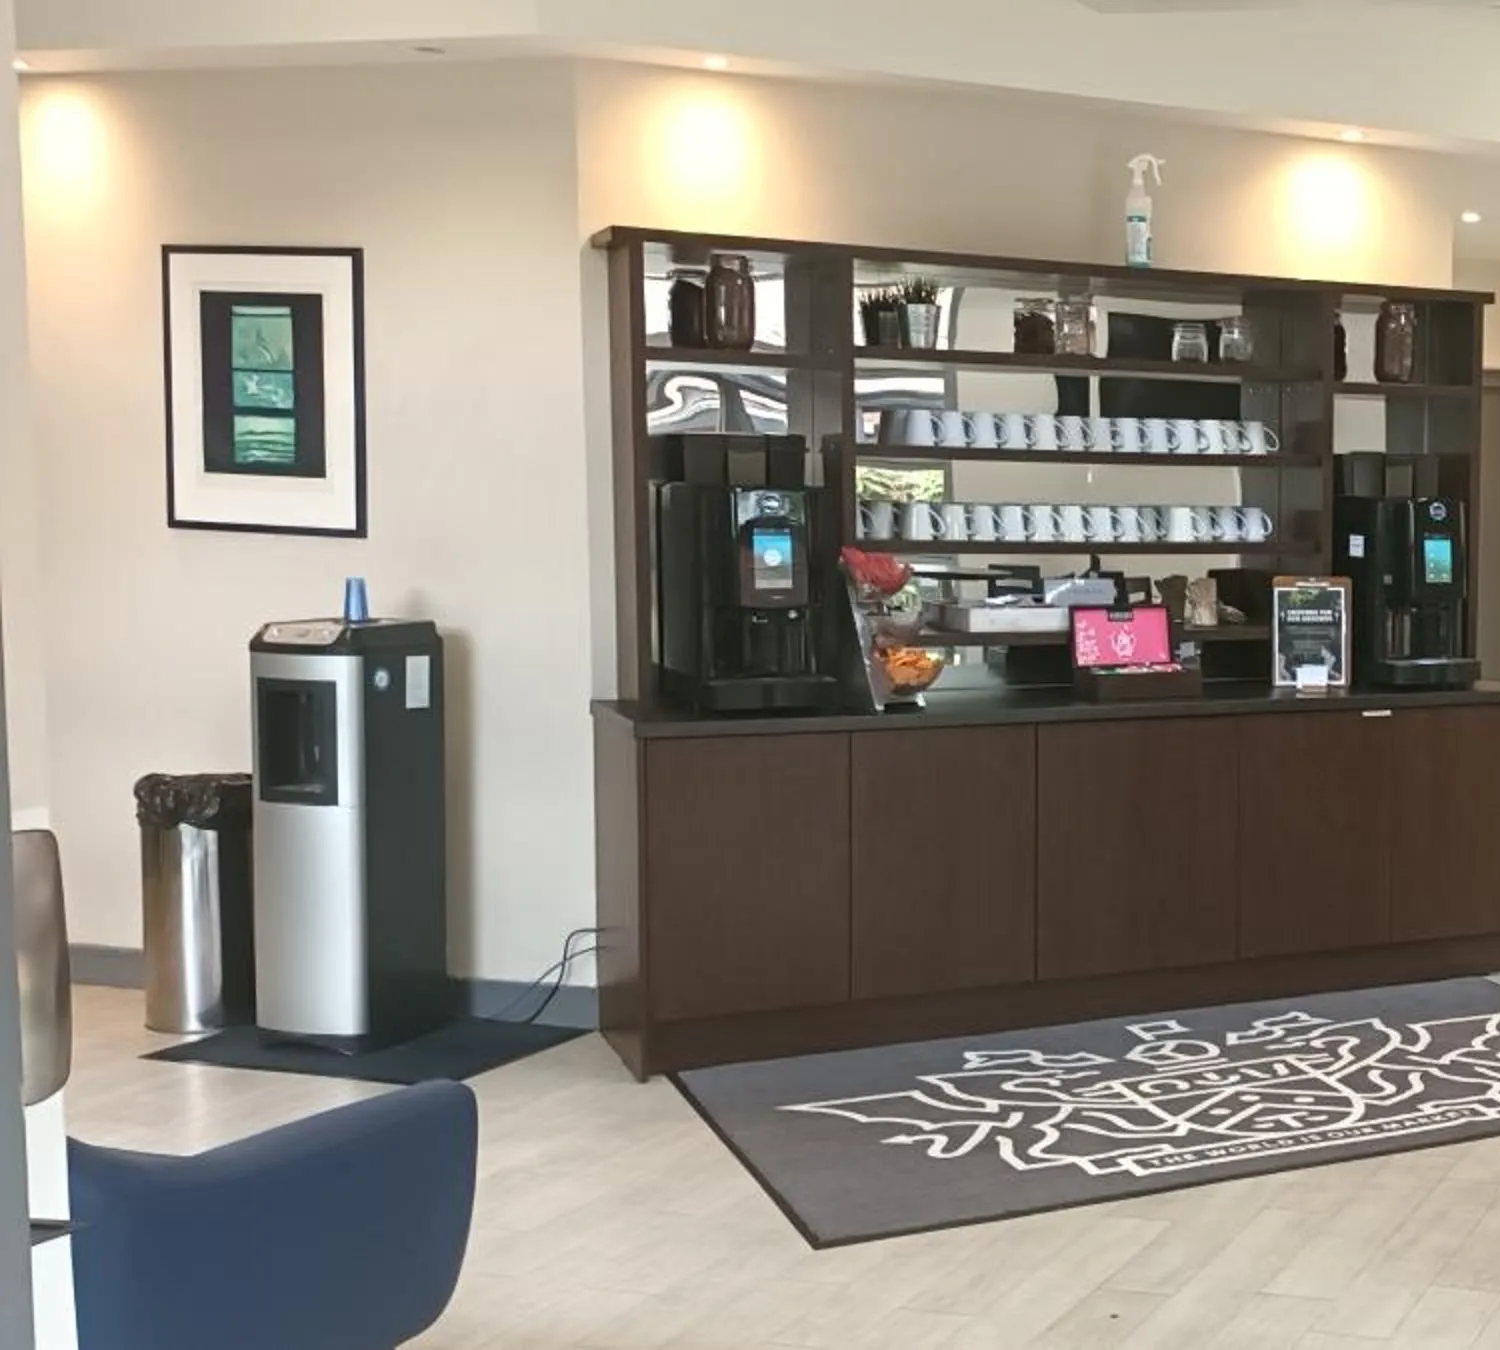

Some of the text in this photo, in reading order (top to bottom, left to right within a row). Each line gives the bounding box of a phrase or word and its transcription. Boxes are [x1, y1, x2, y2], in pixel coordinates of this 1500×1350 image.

[1147, 1108, 1472, 1168] THE WORLD IS OUR MARKET
